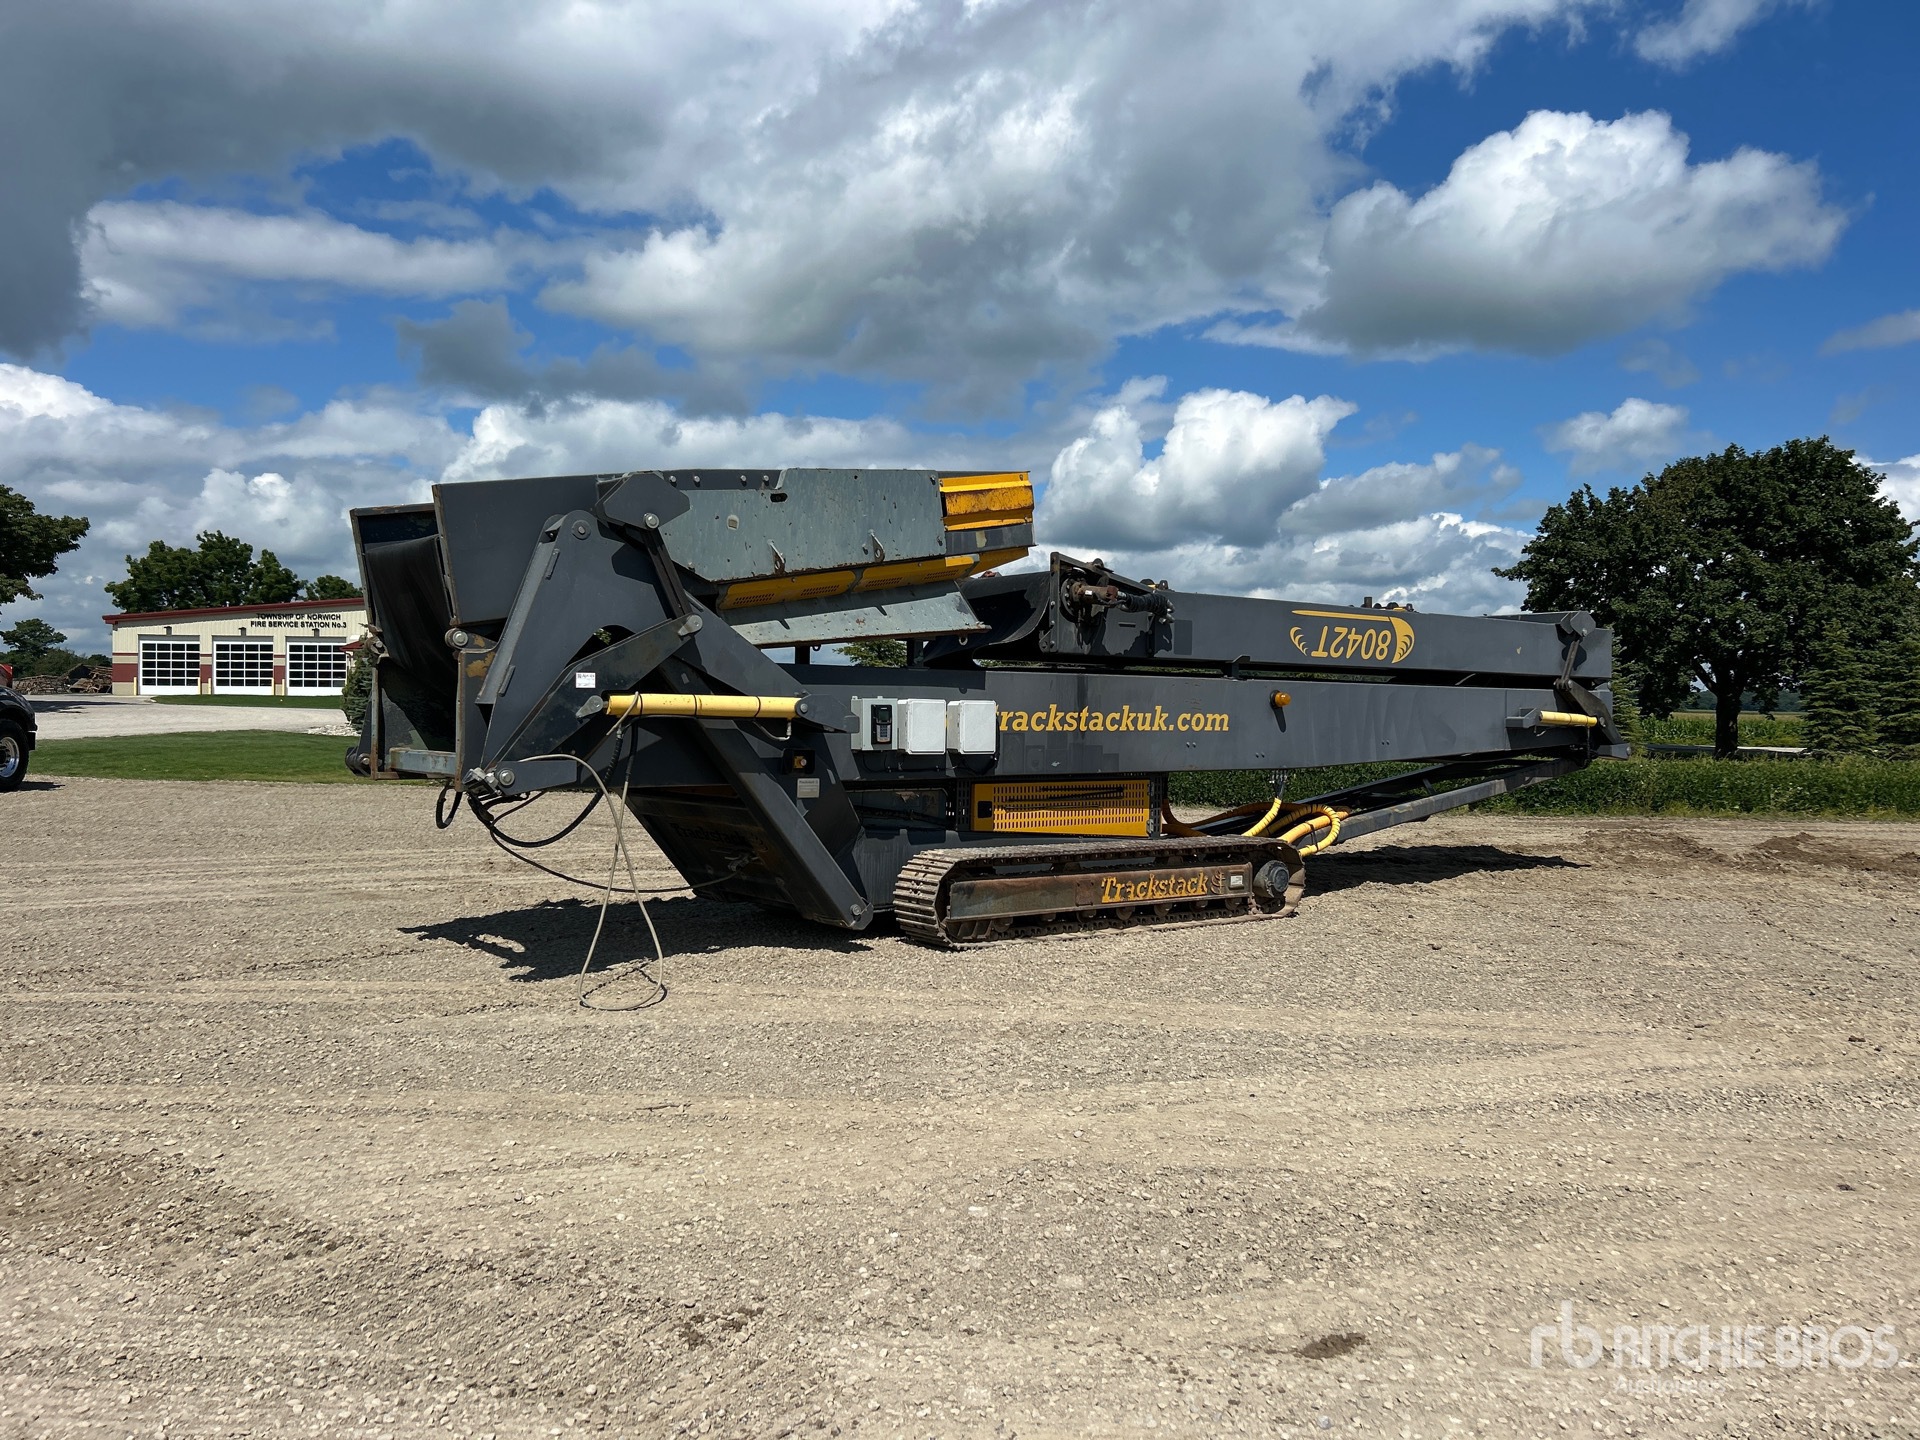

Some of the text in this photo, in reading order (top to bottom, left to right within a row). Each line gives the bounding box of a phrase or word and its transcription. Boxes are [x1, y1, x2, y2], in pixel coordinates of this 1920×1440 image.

[250, 620, 267, 628] FIRE
[300, 621, 330, 629] STATION
[331, 621, 347, 629] No.3
[256, 612, 341, 621] TOWNSHIP OF NORWICH
[1311, 625, 1392, 661] 8042T
[1101, 871, 1209, 904] Trackstack
